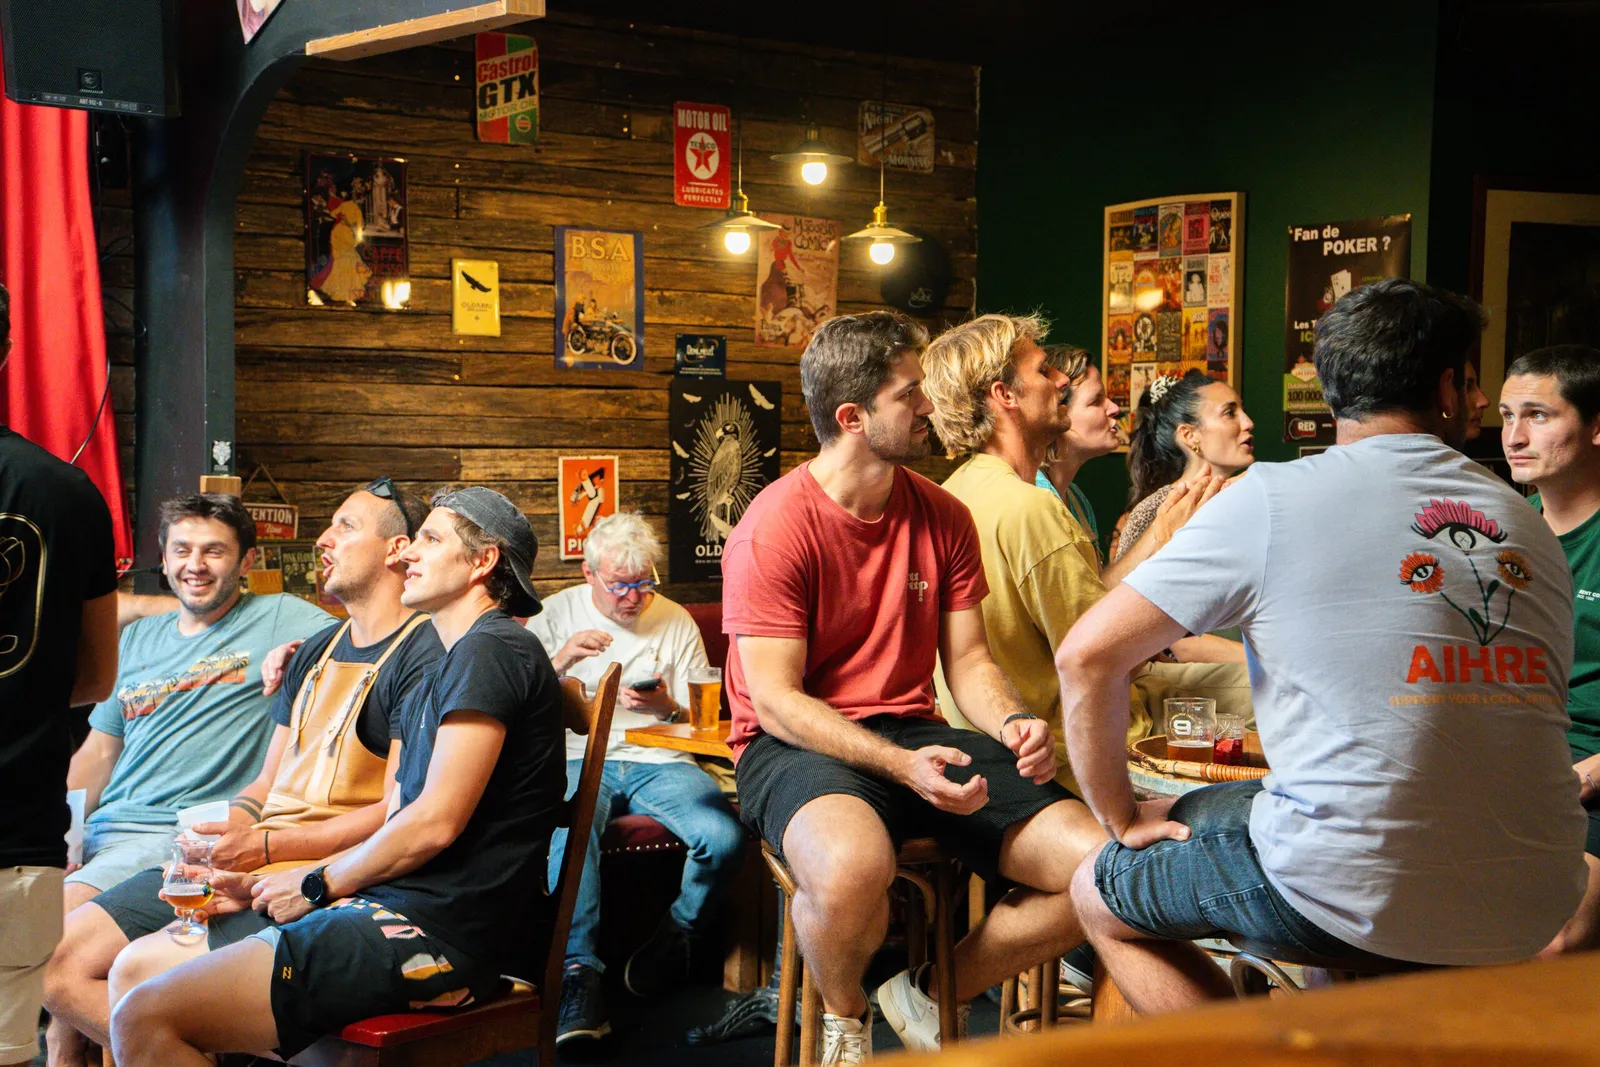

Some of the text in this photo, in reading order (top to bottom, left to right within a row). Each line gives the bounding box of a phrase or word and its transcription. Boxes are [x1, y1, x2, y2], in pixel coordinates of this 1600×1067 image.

[477, 49, 537, 83] Castrol
[479, 71, 536, 109] GTX
[480, 103, 517, 121] MOTOR
[677, 109, 727, 132] MOTOR OIL
[682, 186, 724, 195] LUBRICATES
[683, 194, 722, 203] PERFECTLY
[1294, 225, 1339, 241] Fan de
[1323, 236, 1391, 256] POKER ?
[1294, 320, 1309, 330] Les
[1300, 331, 1313, 342] IC
[1288, 390, 1304, 401] 100
[1298, 421, 1316, 432] RED
[247, 507, 292, 524] TENTION
[695, 544, 723, 557] OLD
[1405, 645, 1547, 684] AIHRE
[1389, 694, 1446, 707] SUPPORT
[1449, 694, 1480, 705] YOUR
[1484, 693, 1520, 704] LOCAL
